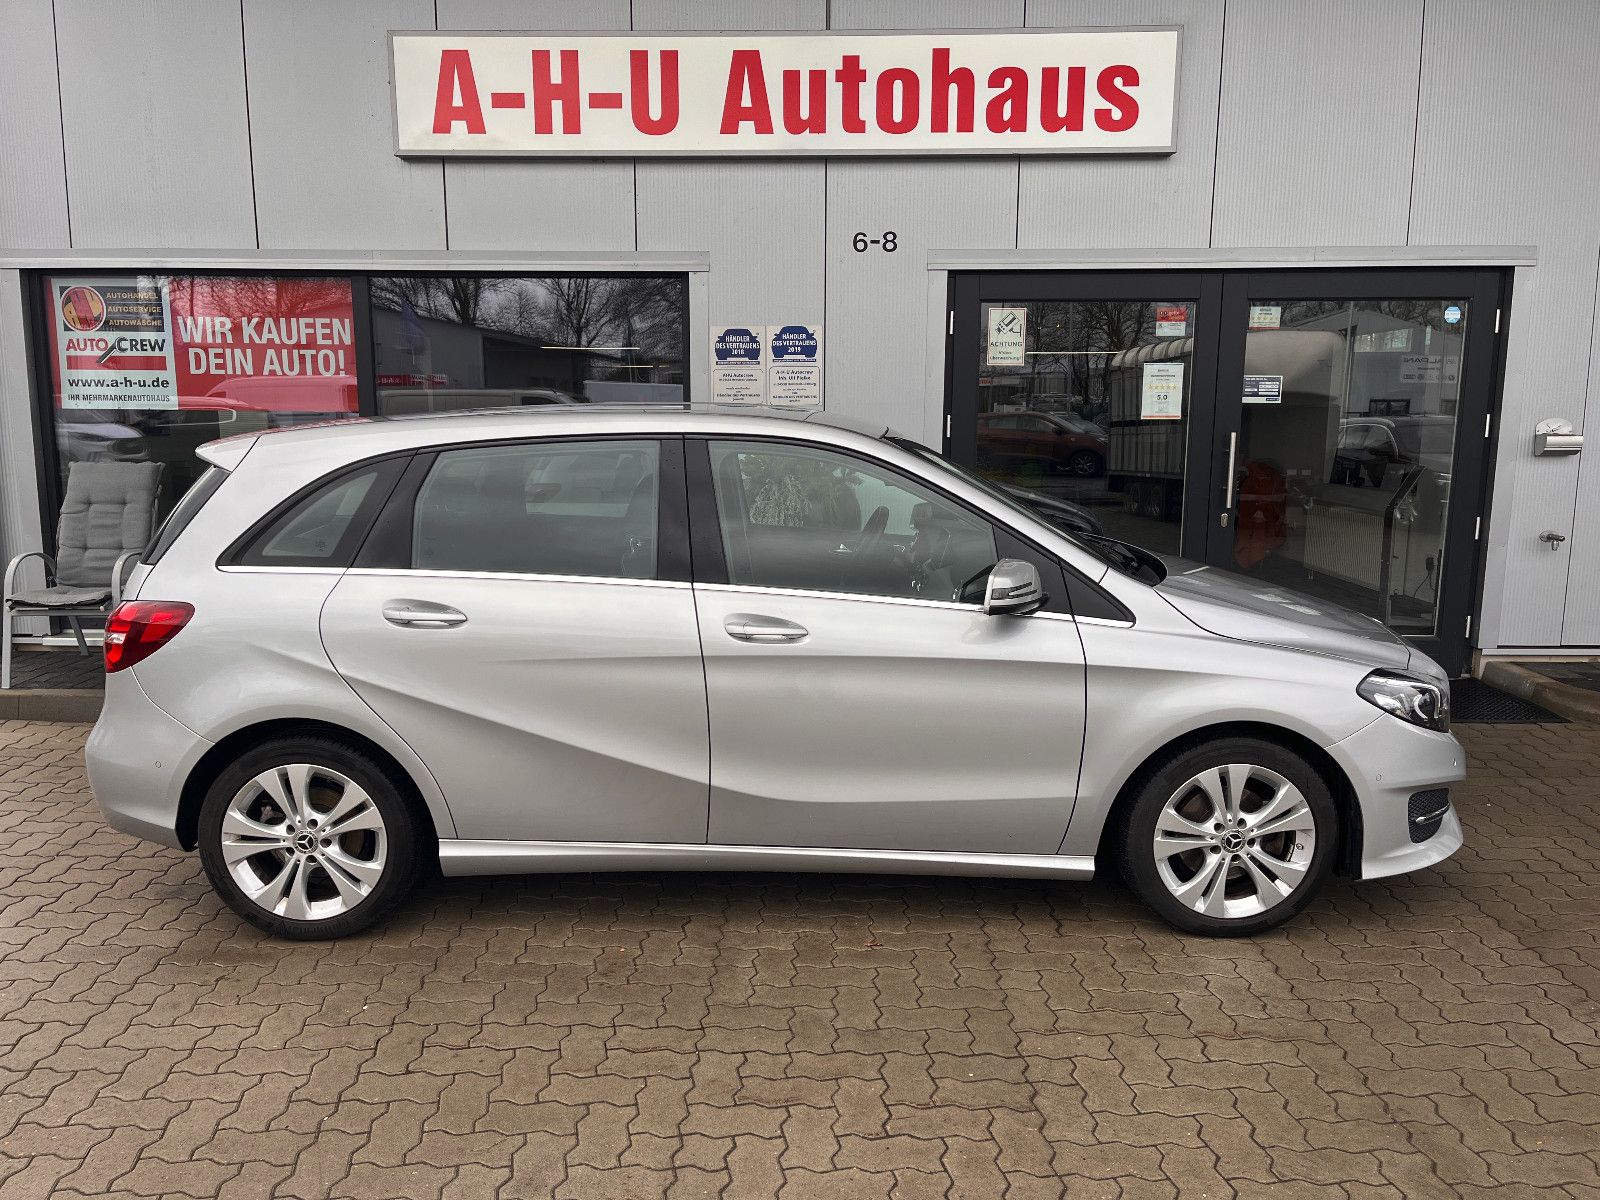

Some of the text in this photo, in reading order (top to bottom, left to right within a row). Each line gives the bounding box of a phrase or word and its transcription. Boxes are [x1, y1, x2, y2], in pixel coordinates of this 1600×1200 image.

[432, 47, 1140, 136] A-H-U Autohaus
[852, 231, 898, 253] 6-8
[107, 305, 162, 313] AUTOSERVICE
[177, 316, 352, 346] WIR KAUFEN
[66, 337, 166, 352] AUTO CREW
[188, 348, 346, 377] DEIN AUTO!
[68, 376, 170, 388] www.a-h-u.de
[82, 394, 170, 402] MEHRMARKENAUTOHAUS
